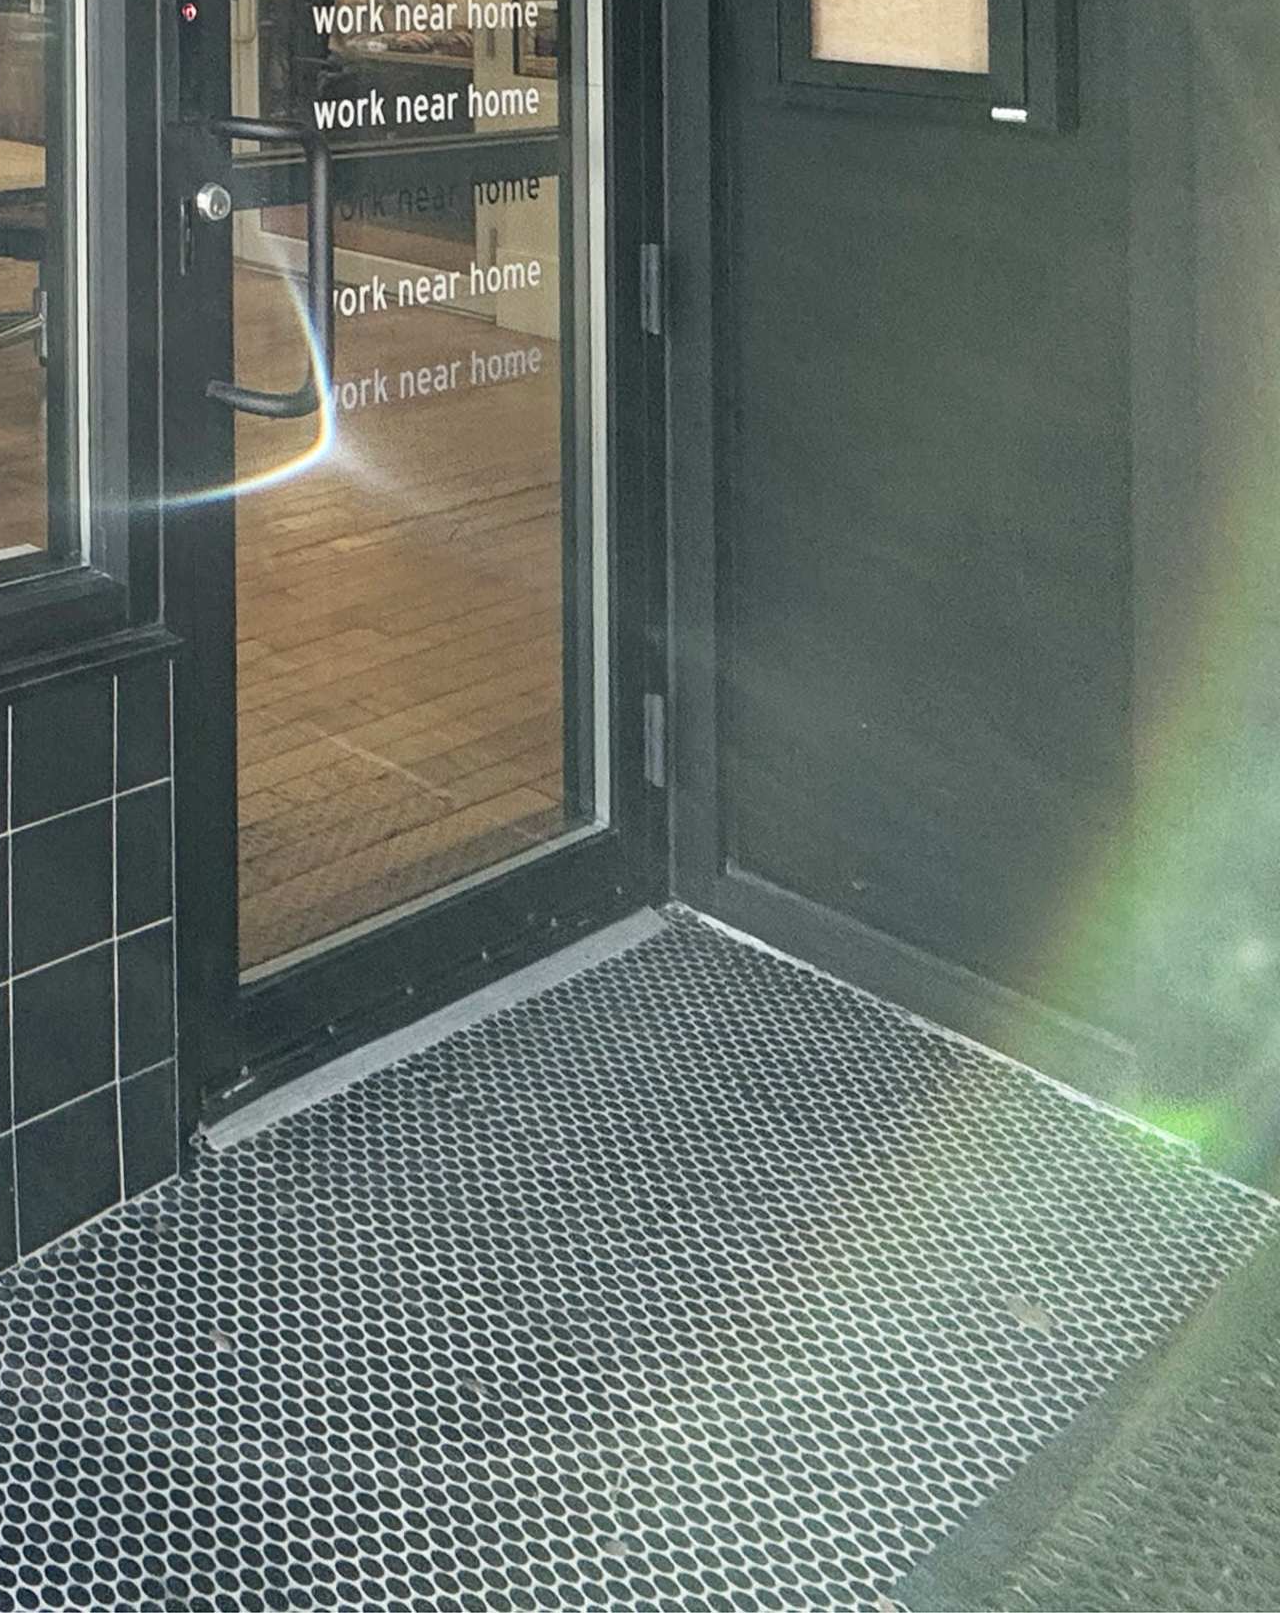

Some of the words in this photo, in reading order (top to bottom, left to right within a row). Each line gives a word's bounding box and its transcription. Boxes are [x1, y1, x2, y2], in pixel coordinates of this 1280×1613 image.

[395, 0, 457, 32] near
[314, 90, 385, 130] work
[396, 91, 458, 124] near
[468, 84, 540, 118] home
[340, 187, 387, 222] ork
[398, 270, 461, 307] near
[470, 259, 542, 296] home
[399, 360, 462, 399] near
[471, 345, 542, 385] home
